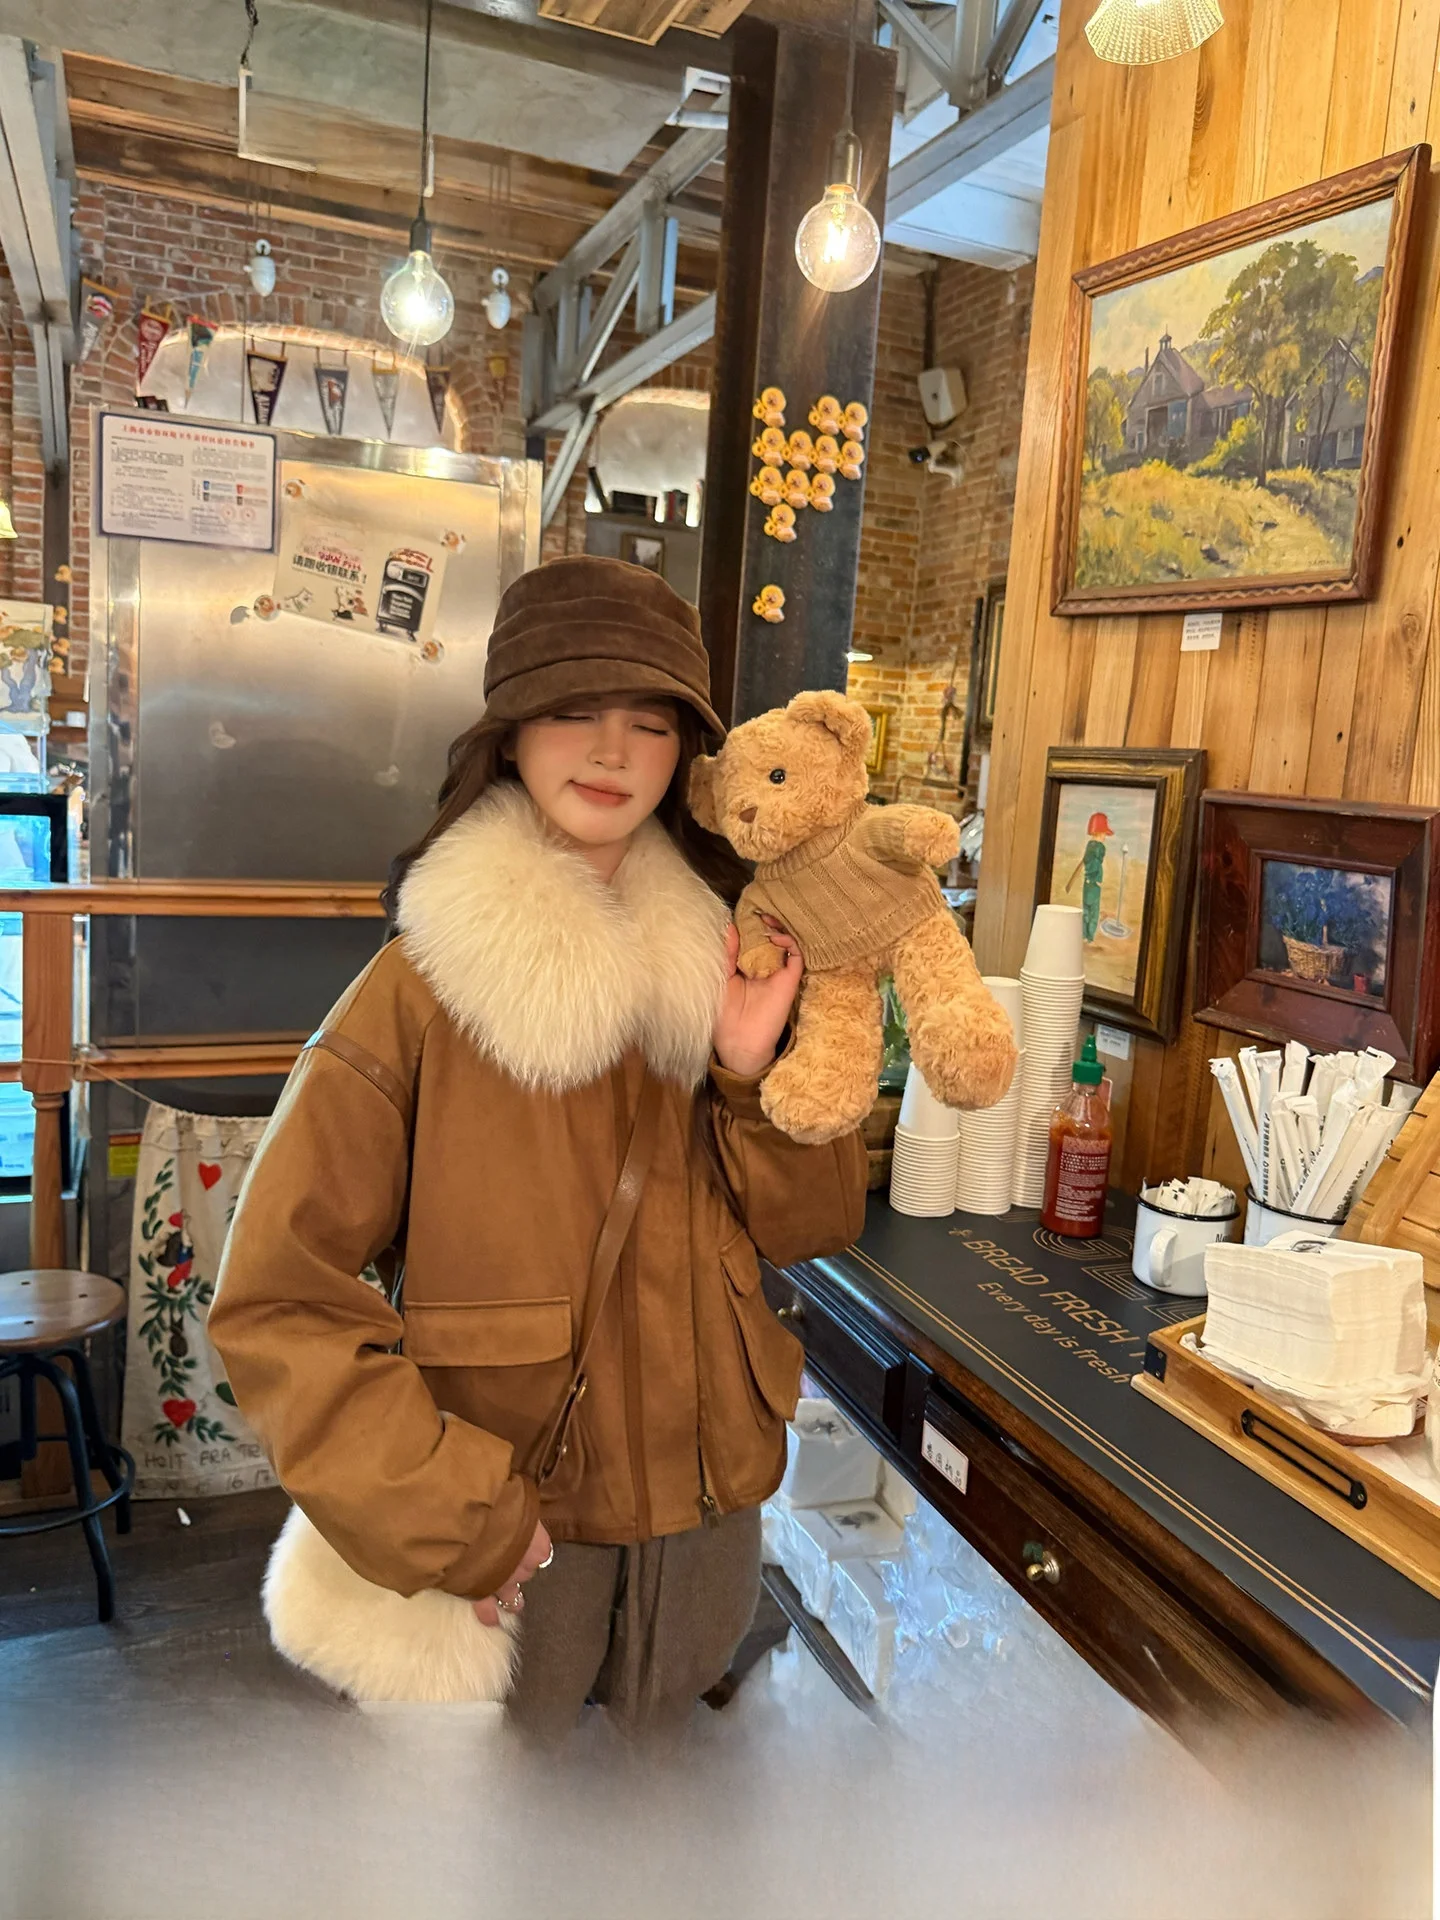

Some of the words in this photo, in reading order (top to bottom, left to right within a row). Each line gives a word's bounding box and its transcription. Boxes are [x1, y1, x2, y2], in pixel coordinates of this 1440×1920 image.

[961, 1240, 1050, 1285] BREAD
[1039, 1291, 1140, 1343] FRESH
[977, 1282, 1031, 1312] Every
[1023, 1314, 1062, 1334] day
[1053, 1335, 1080, 1349] is
[1072, 1349, 1132, 1384] fresh
